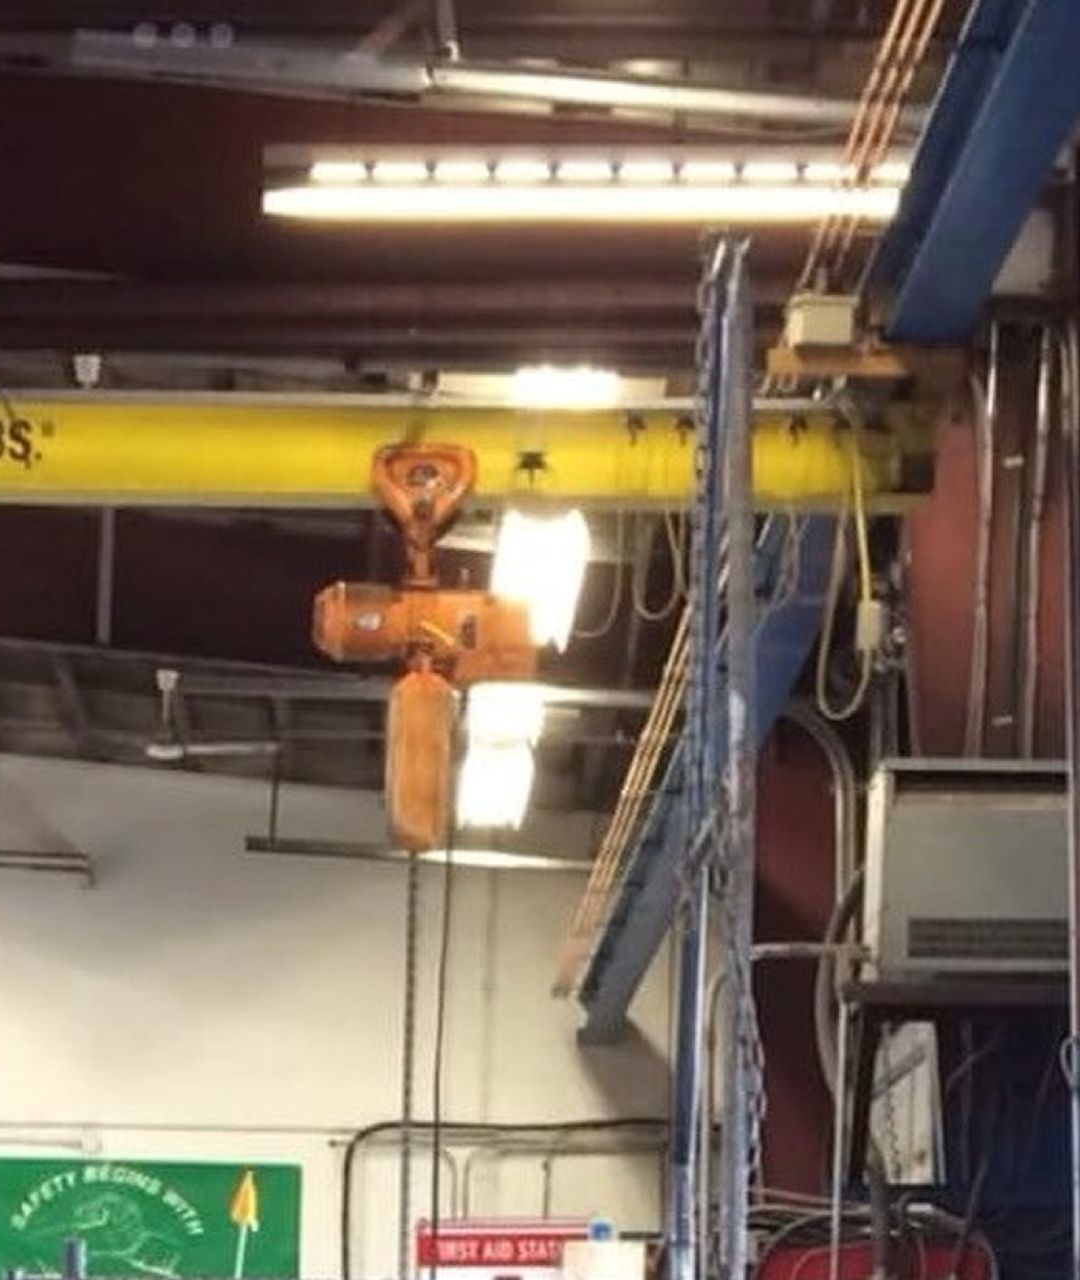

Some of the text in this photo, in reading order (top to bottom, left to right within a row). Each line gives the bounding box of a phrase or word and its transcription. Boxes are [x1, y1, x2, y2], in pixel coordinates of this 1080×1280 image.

[9, 1165, 205, 1236] SAFETY BEGINS WITH
